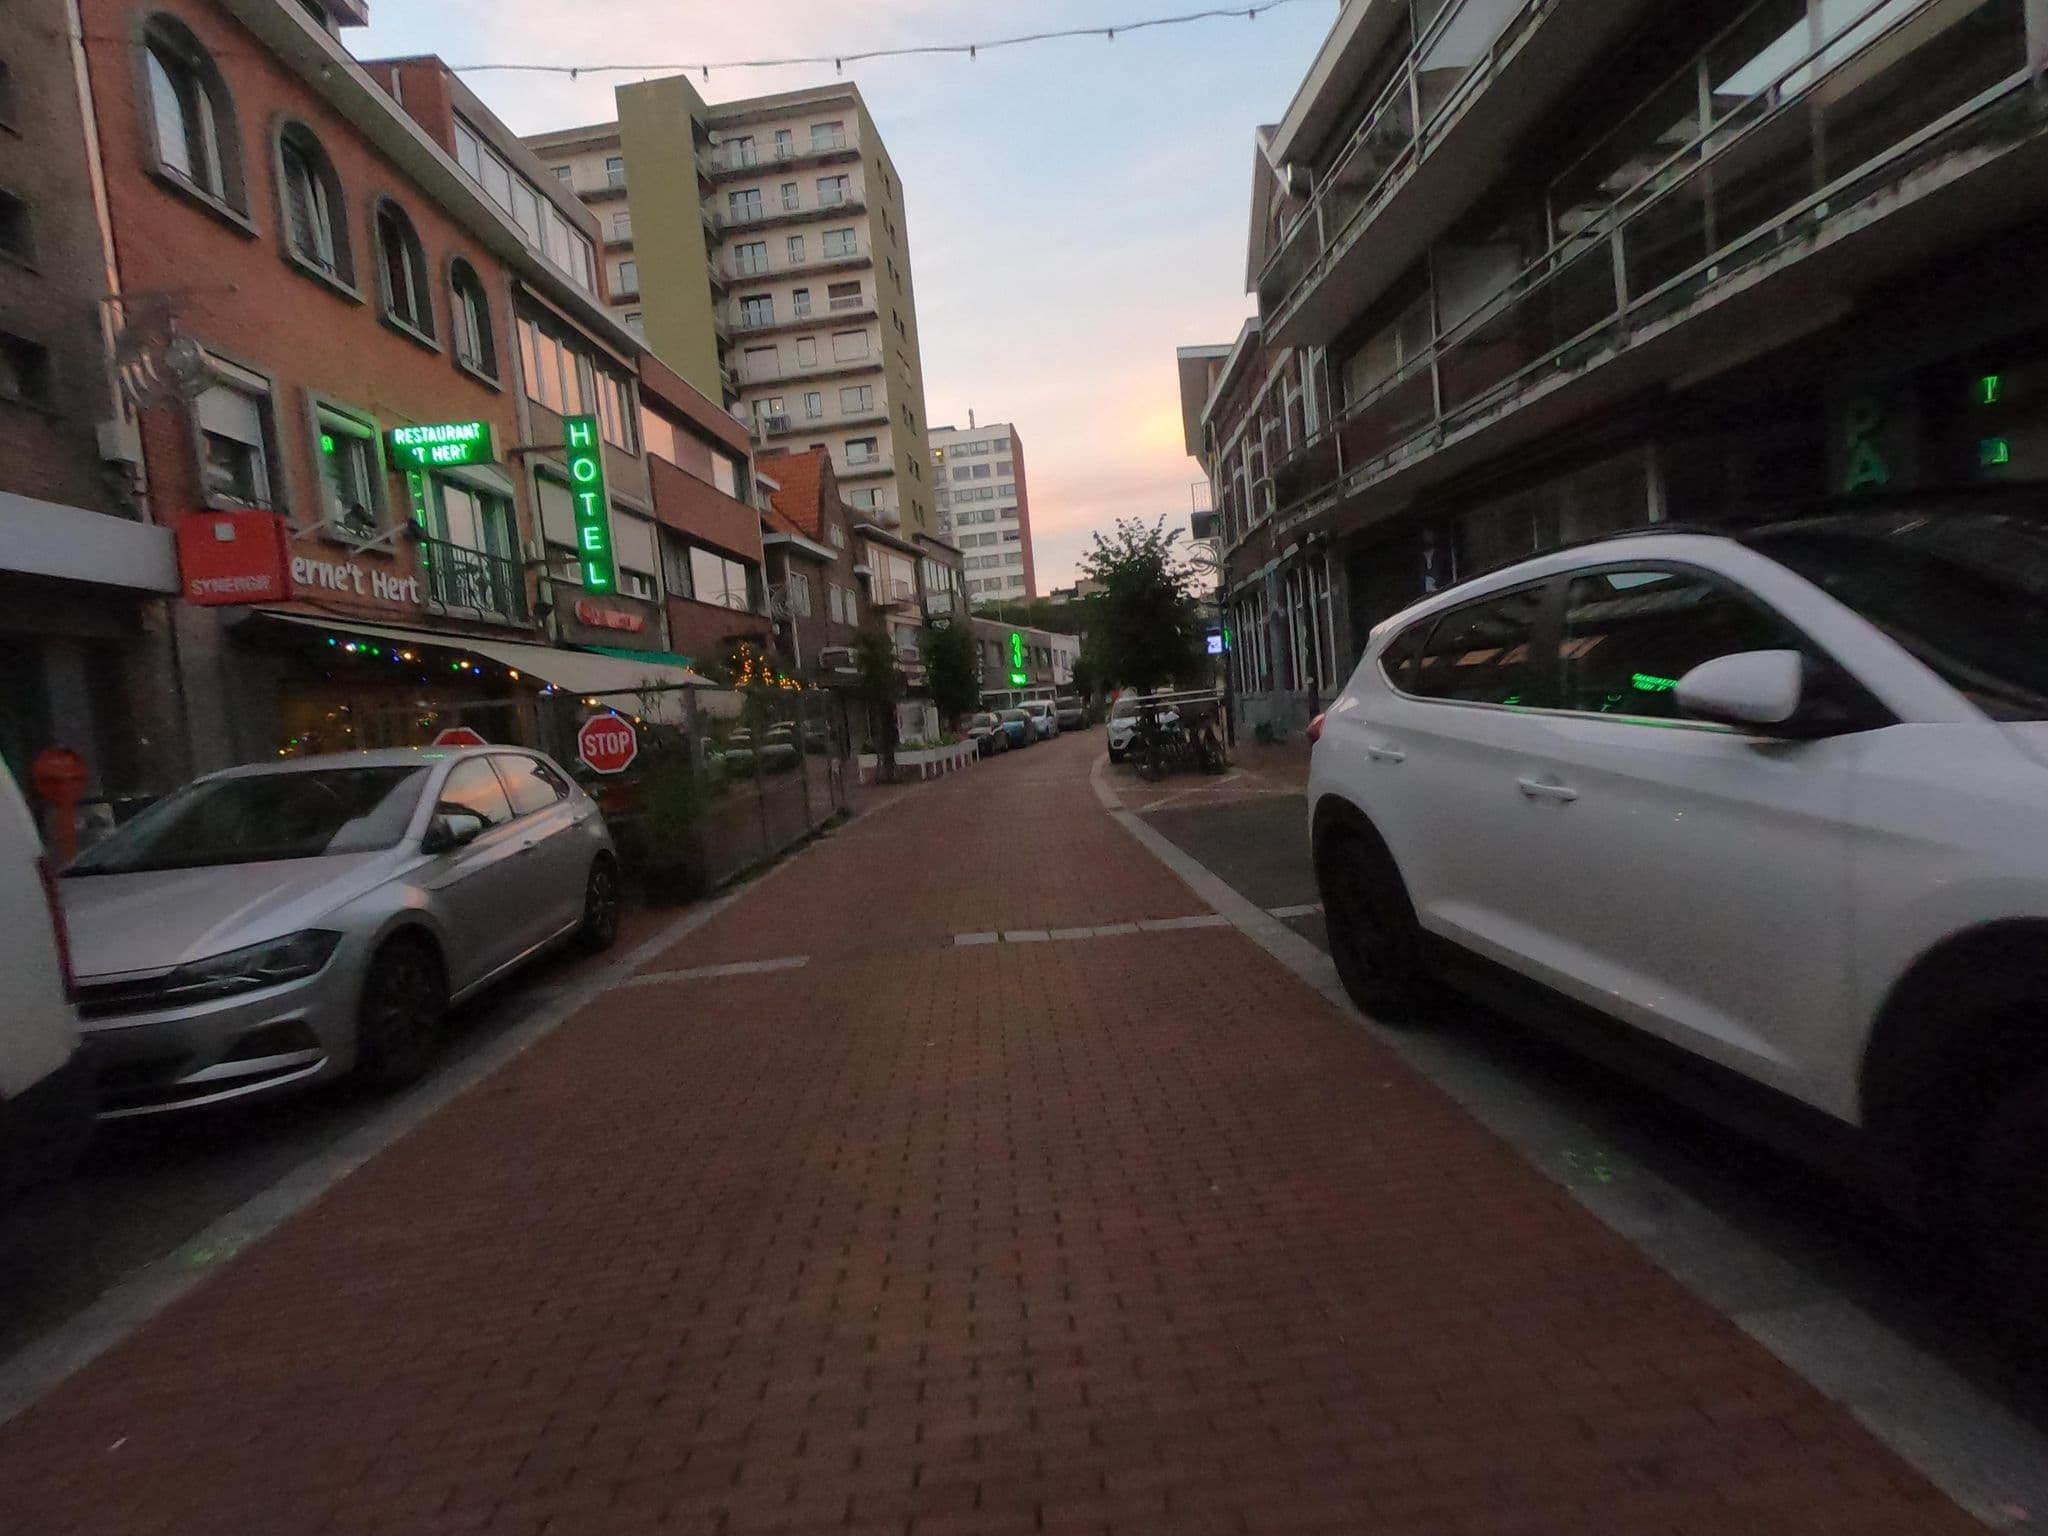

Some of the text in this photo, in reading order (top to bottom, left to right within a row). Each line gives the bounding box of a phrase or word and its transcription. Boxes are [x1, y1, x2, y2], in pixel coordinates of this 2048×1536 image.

[393, 422, 481, 445] RESTAURANT
[411, 443, 468, 463] 'T HERT
[570, 422, 607, 584] HOTEL
[371, 569, 421, 604] Hert
[584, 731, 630, 757] STOP
